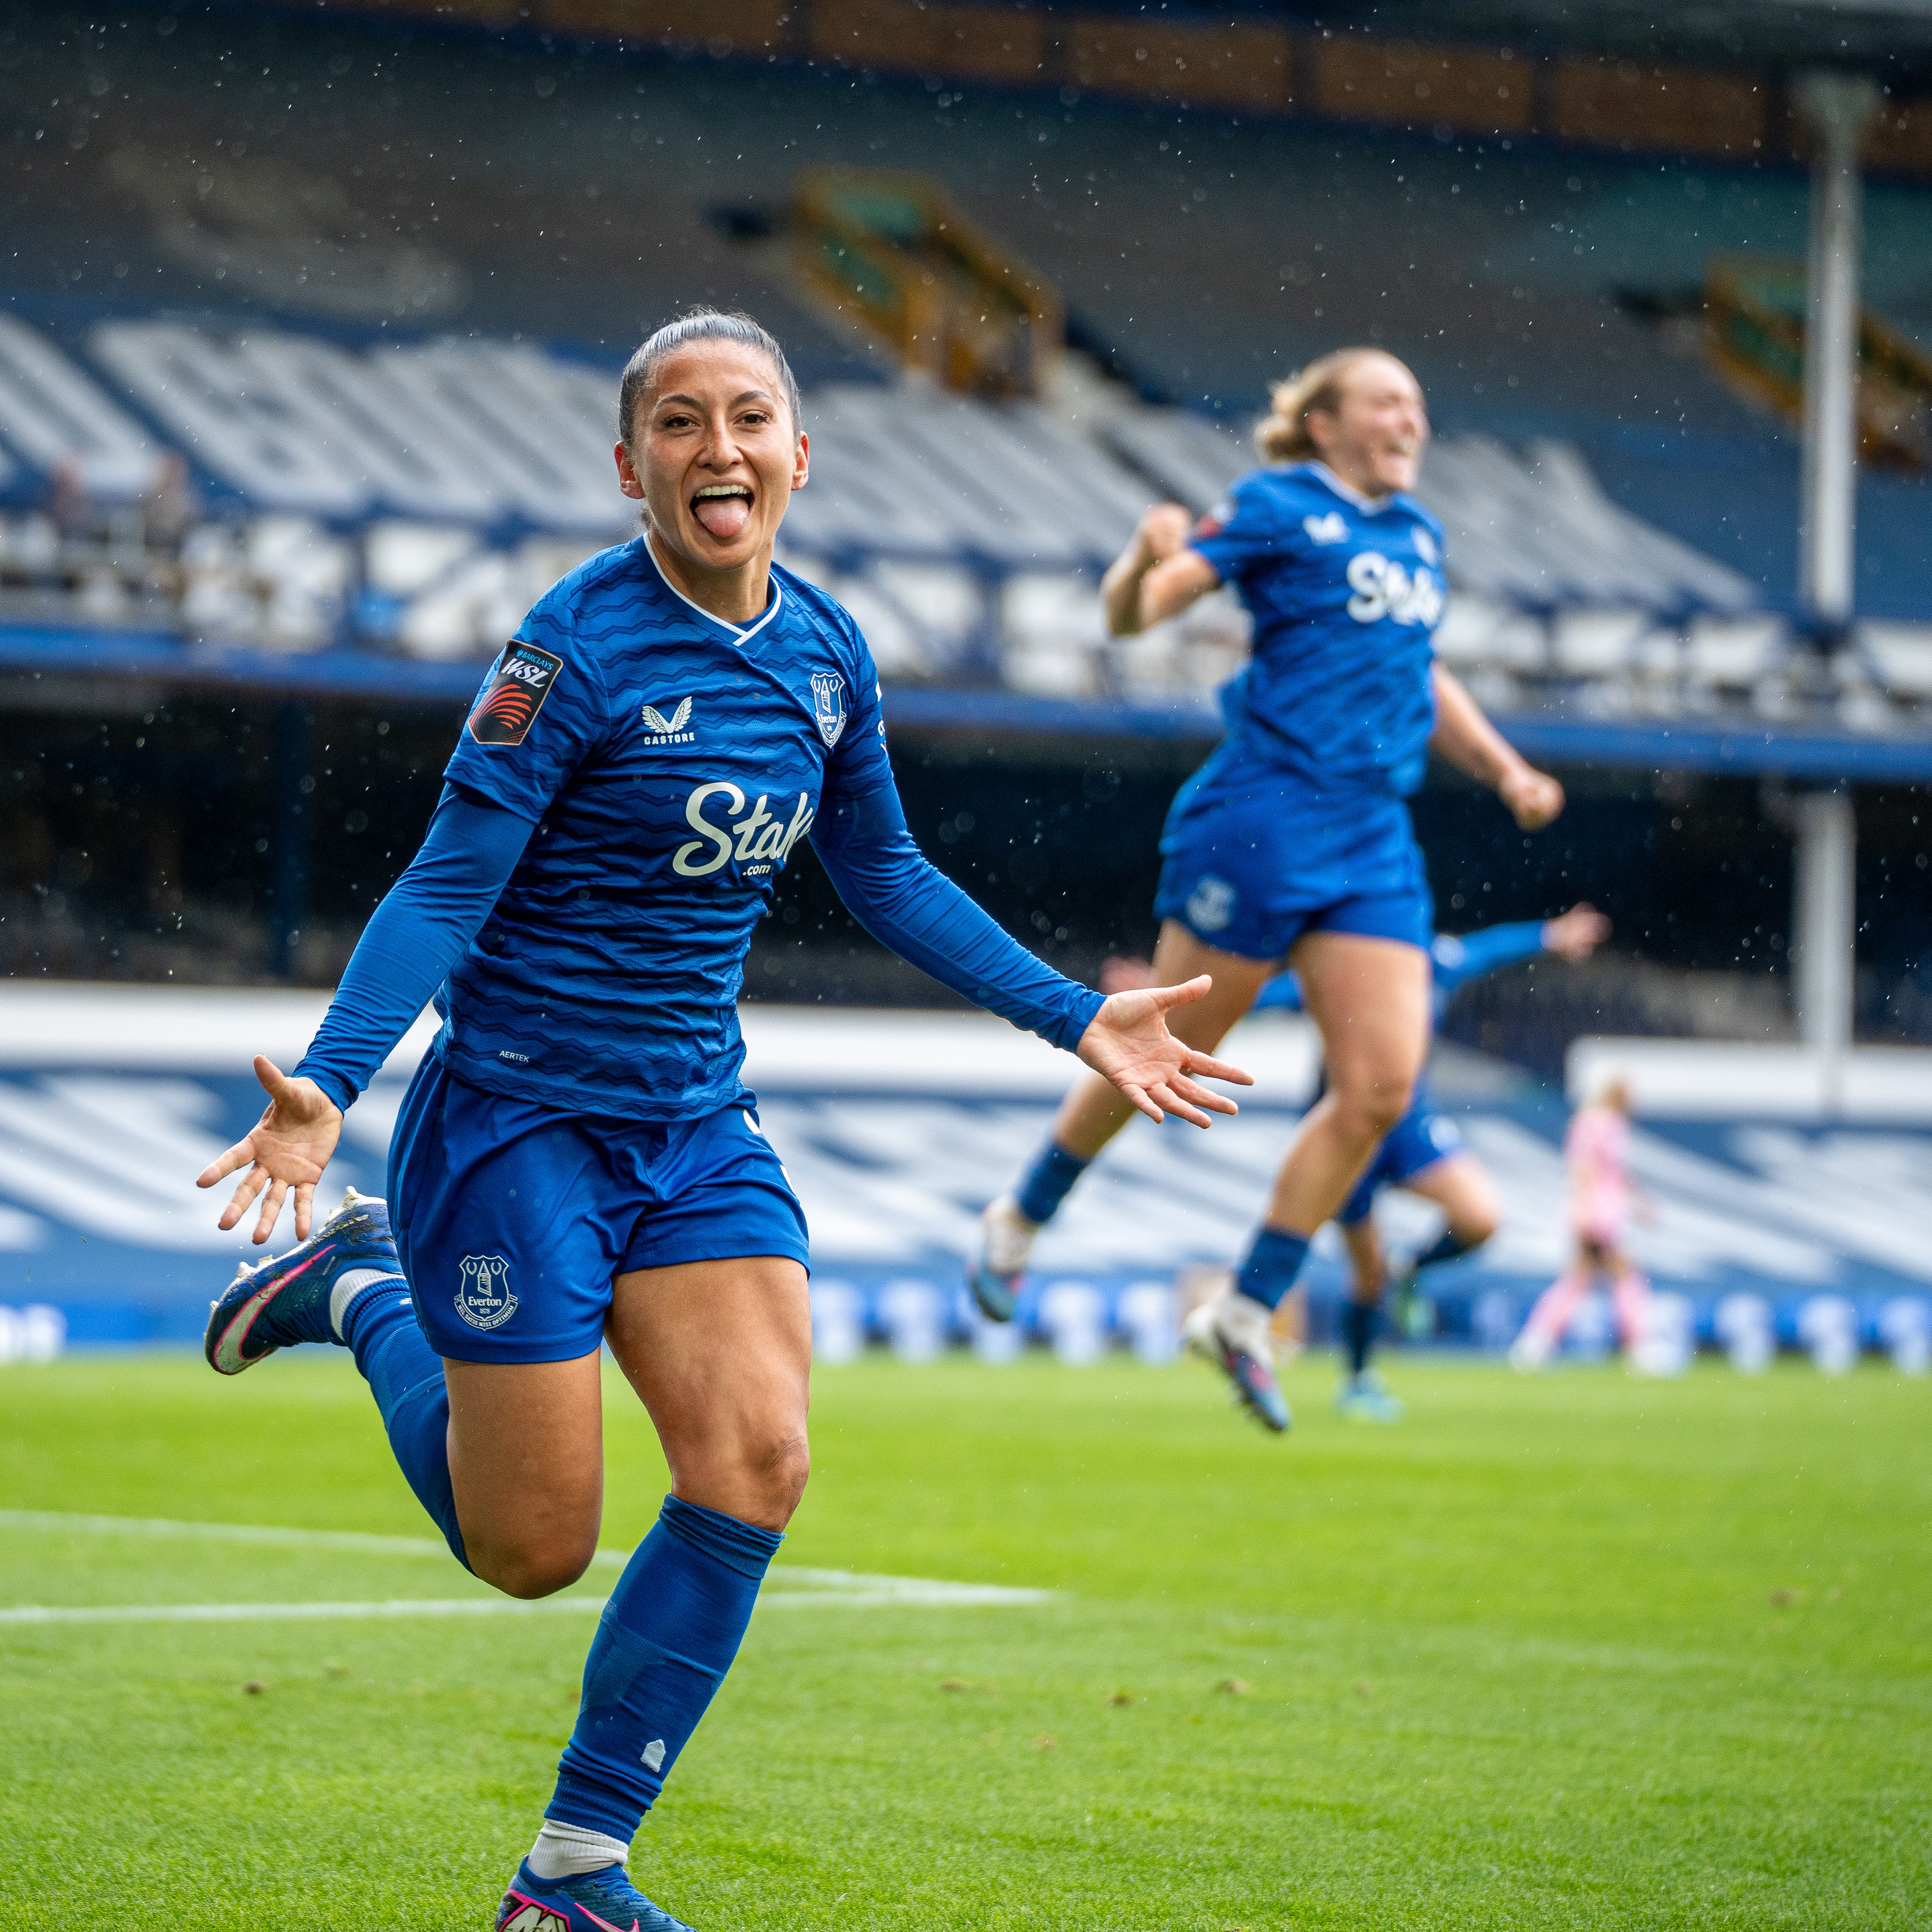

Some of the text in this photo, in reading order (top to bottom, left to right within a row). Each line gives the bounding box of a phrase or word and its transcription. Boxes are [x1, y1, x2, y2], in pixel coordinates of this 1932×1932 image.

[522, 652, 554, 670] BARCLAYS
[501, 658, 548, 688] WSL
[644, 732, 695, 745] CASTORE
[743, 864, 771, 876] .com
[499, 1050, 530, 1063] AERTEK
[468, 1296, 502, 1306] Everton
[492, 1305, 515, 1326] OPTIMUM
